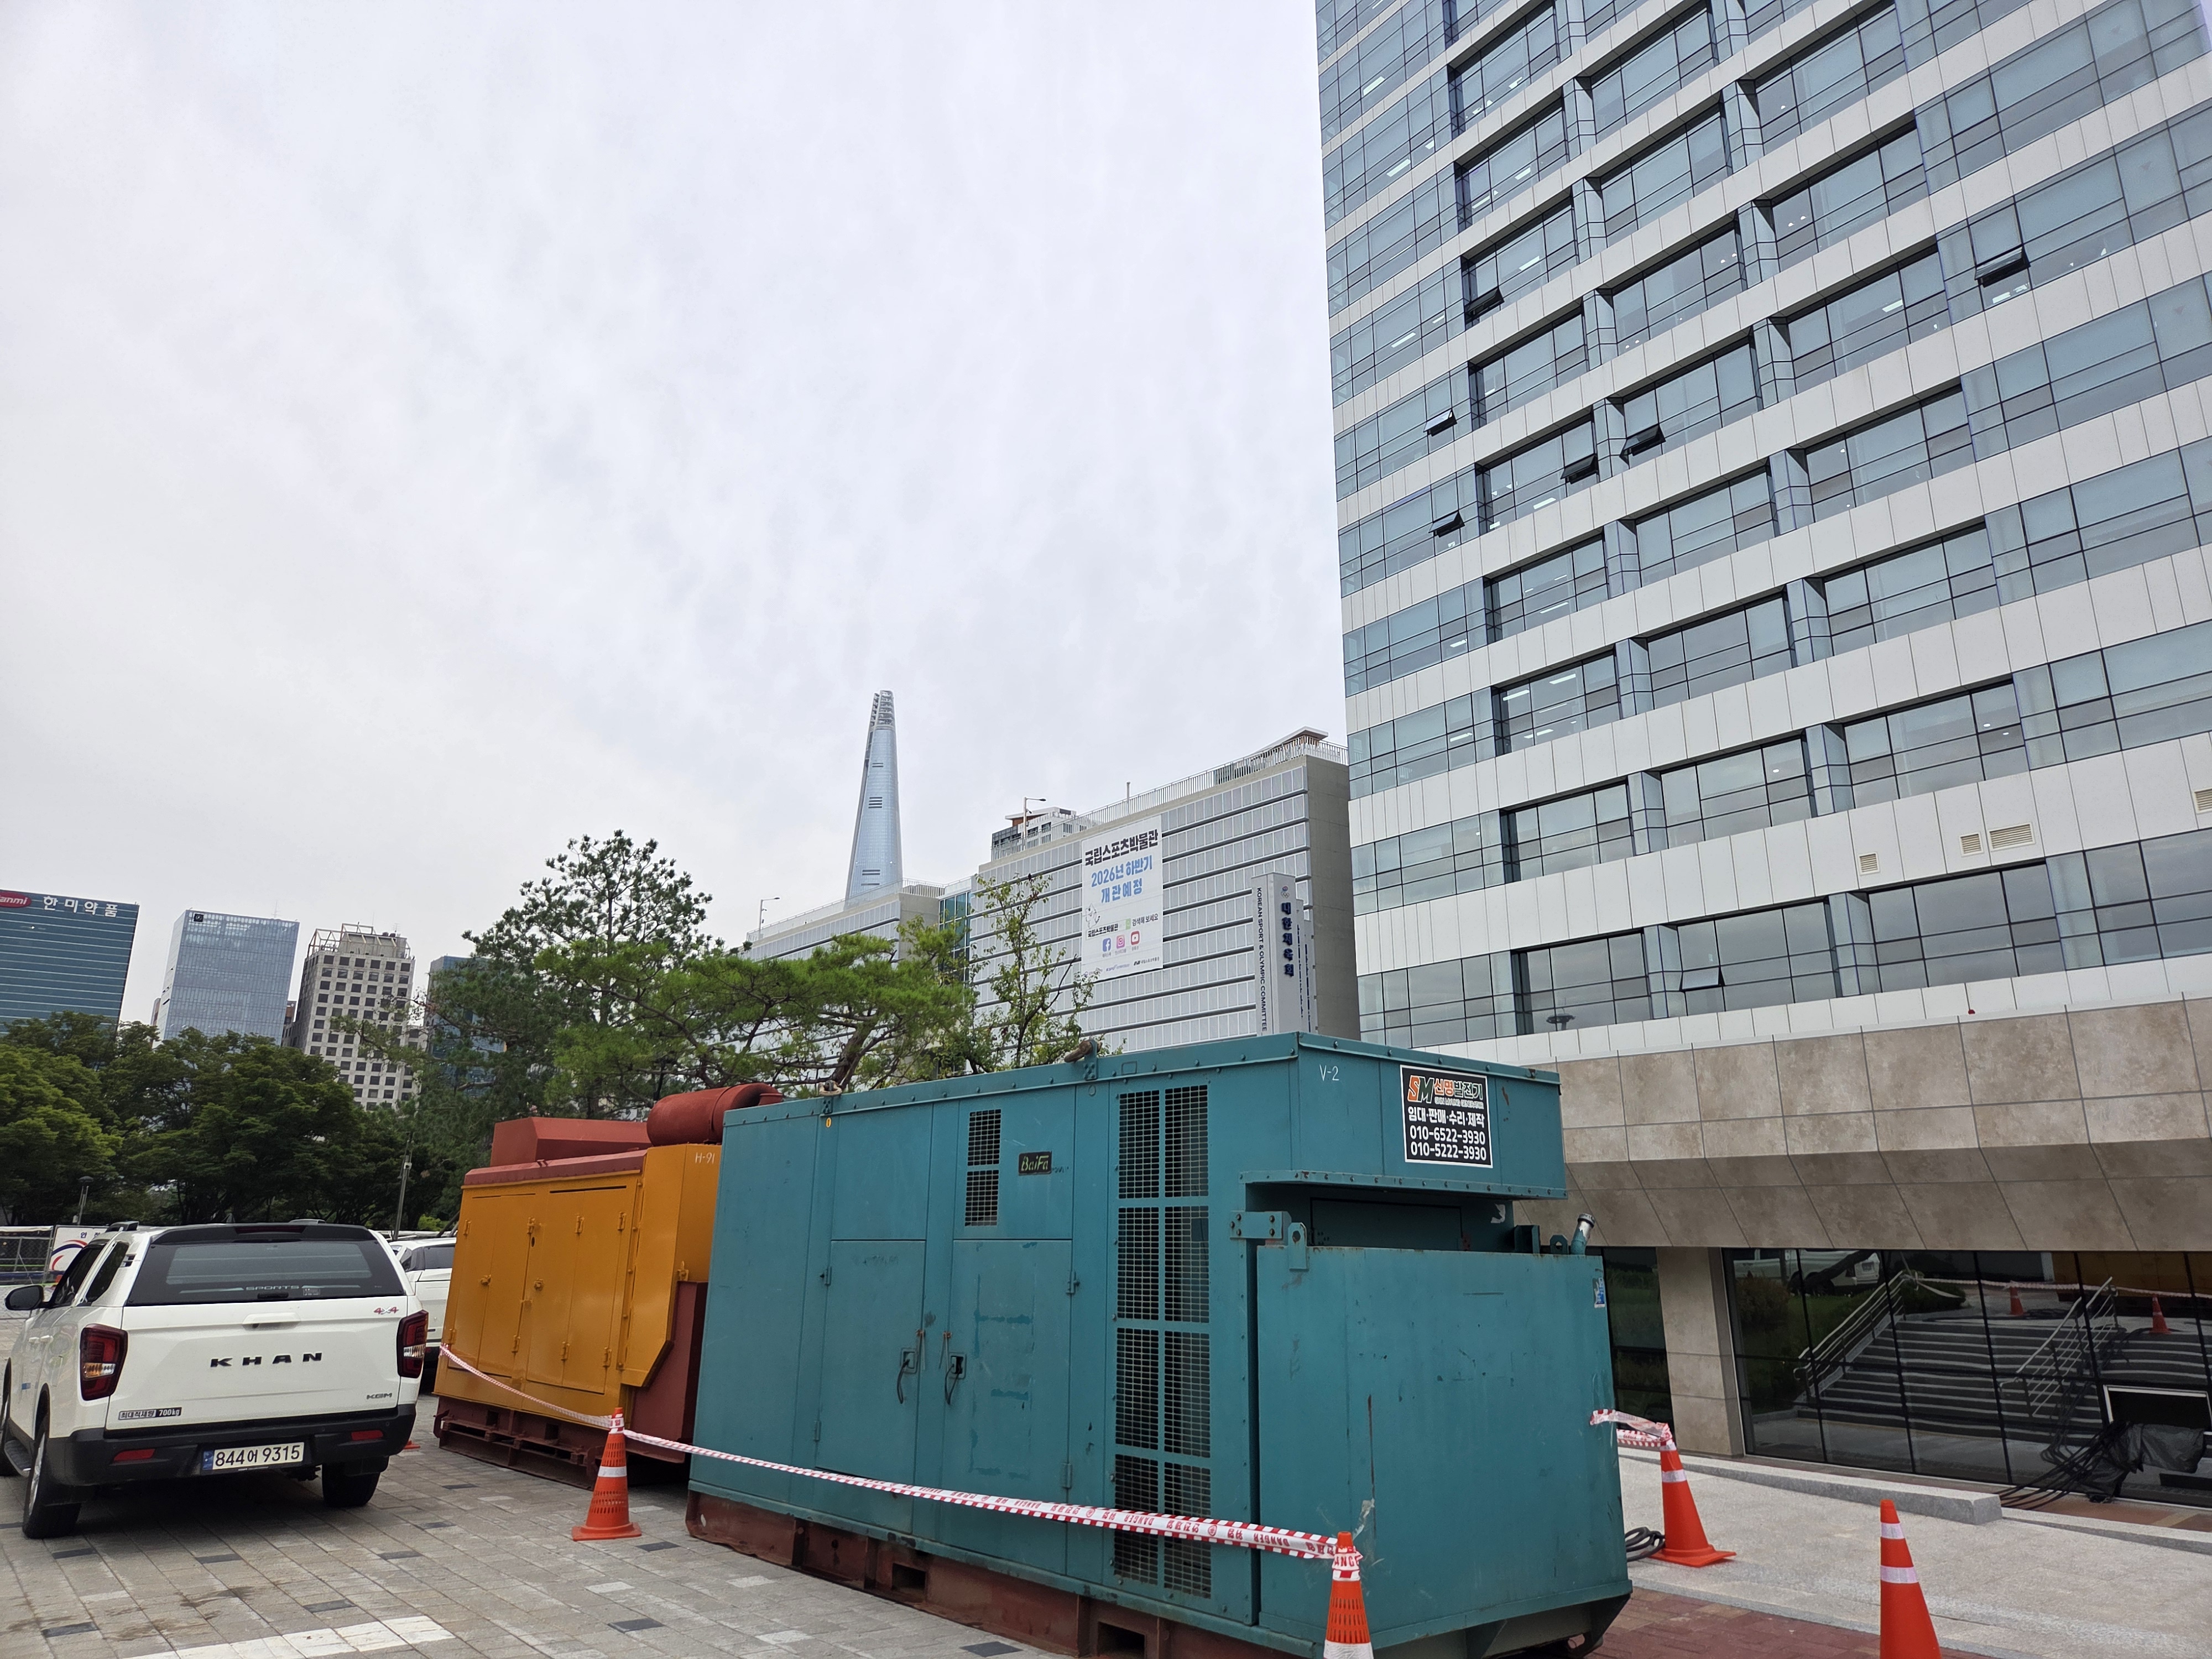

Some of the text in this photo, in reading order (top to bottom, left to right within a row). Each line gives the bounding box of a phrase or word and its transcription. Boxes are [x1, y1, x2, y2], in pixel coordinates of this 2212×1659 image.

[1084, 829, 1159, 867] 국립스포츠박물관
[1091, 855, 1152, 888] 2026년 하반기
[1101, 878, 1142, 904] 개관예정
[0, 895, 28, 905] anmi
[43, 896, 118, 917] 한미약품
[1133, 913, 1159, 927] 검색해 보세요
[1088, 924, 1119, 938] 국립스포츠박물관
[1319, 1064, 1340, 1082] V-2
[1407, 1075, 1484, 1104] SM 신명발전기
[1410, 1125, 1486, 1145] 010-6522-3930
[1411, 1141, 1487, 1161] 010-5222-3930
[210, 1352, 322, 1368] KHAN
[121, 1408, 180, 1418] 최대적재량 700kg
[215, 1445, 300, 1467] 844어 9315
[1124, 1515, 1154, 1526] DANGER
[1166, 1520, 1200, 1533] 안전제일
[1228, 1528, 1243, 1541] 위험
[1254, 1533, 1290, 1547] DANGER
